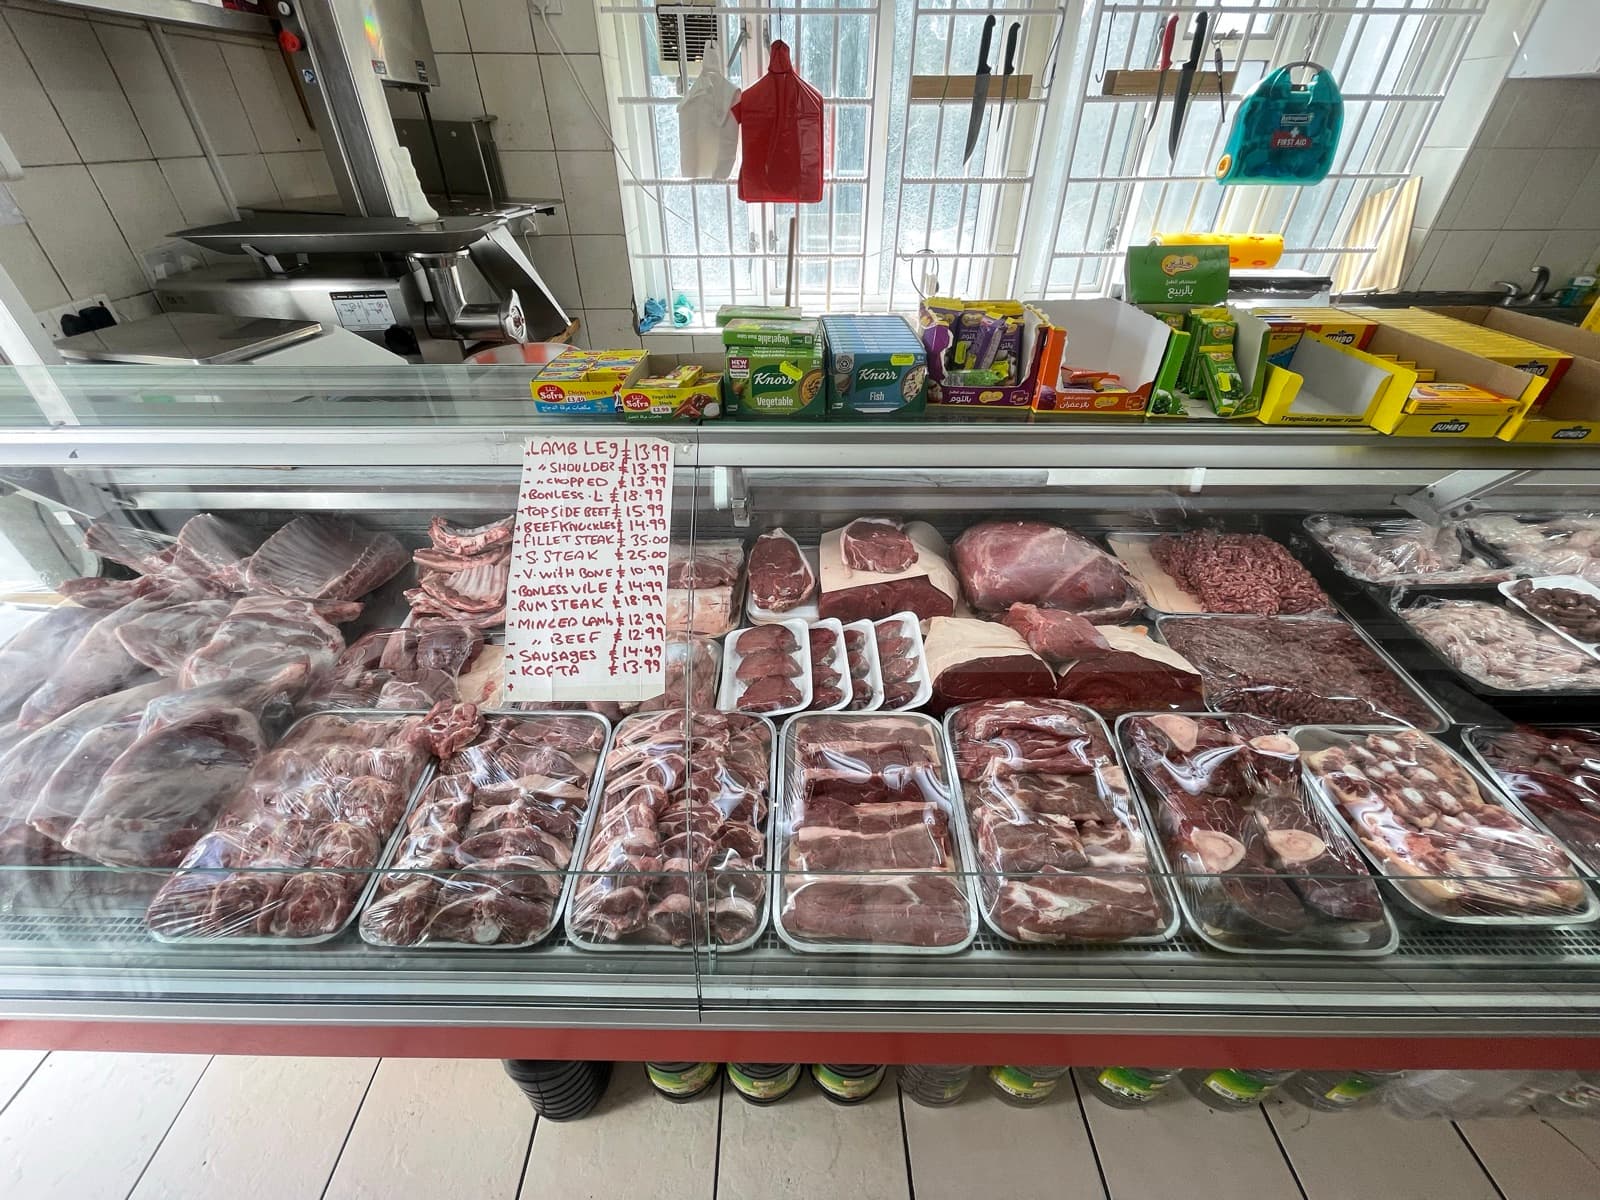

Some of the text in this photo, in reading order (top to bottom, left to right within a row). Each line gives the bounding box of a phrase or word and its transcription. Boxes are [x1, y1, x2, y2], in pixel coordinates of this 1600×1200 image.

[758, 333, 789, 344] Vegetable
[753, 369, 794, 385] Knorr
[859, 367, 897, 381] Knorr
[540, 391, 563, 401] Sofra
[869, 391, 885, 401] Fish
[626, 400, 649, 408] Sofra
[757, 396, 793, 409] Vegetable
[1433, 423, 1466, 431] JUMBO
[1554, 430, 1588, 438] JUMBO
[530, 441, 578, 455] LAMB
[550, 462, 615, 473] SHOULDER
[547, 477, 608, 487] CHOPPED
[575, 535, 615, 544] STEAK
[544, 550, 598, 560] STEAK
[571, 582, 608, 594] VILE
[518, 600, 547, 612] RUM
[552, 598, 603, 612] STEAK
[551, 631, 602, 645] BEEF
[522, 665, 580, 677] KOFTA
